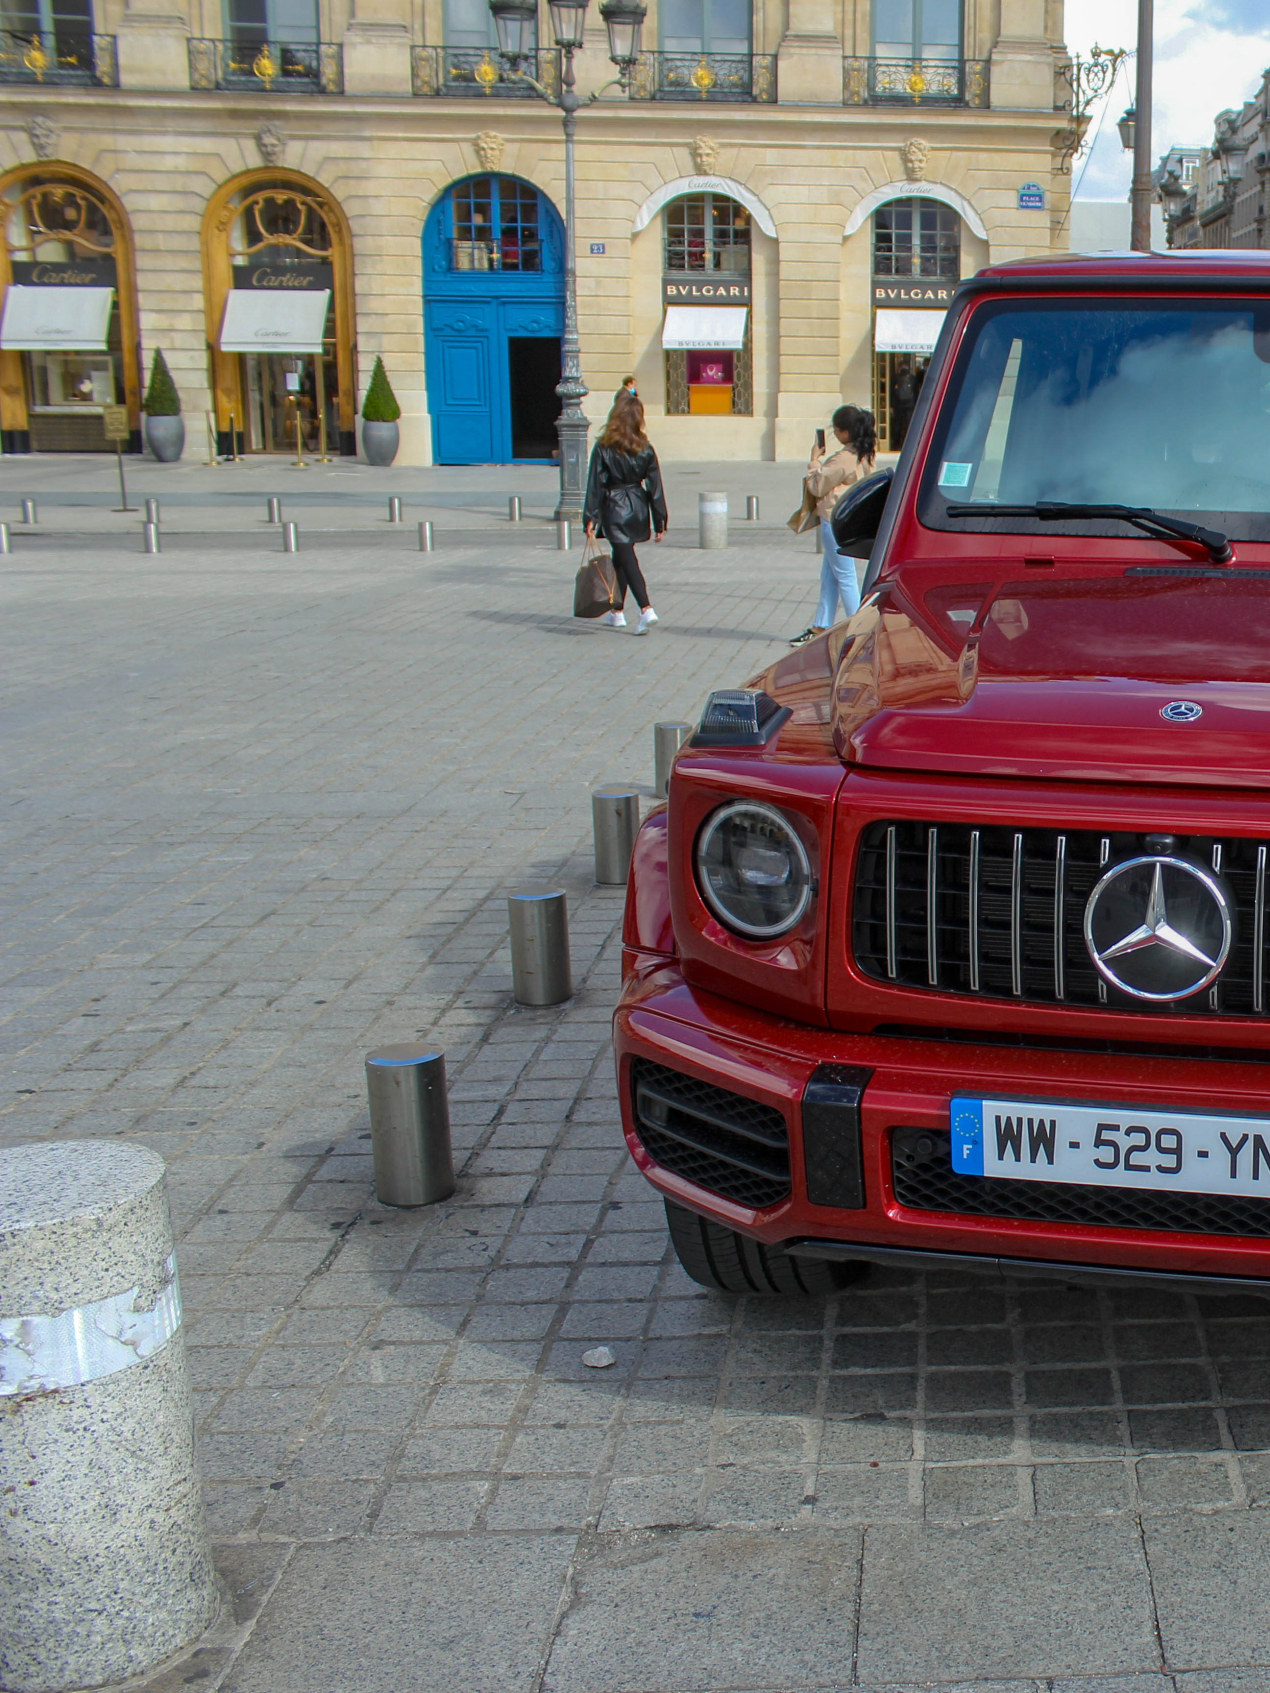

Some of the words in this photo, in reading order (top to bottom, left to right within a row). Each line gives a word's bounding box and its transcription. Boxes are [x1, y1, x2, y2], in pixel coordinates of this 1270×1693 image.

[687, 177, 722, 189] Cartier
[899, 182, 934, 194] Cartier
[592, 244, 604, 254] 23
[31, 263, 98, 285] Cartier
[251, 267, 315, 288] Cartier
[666, 285, 749, 296] BVLGARI
[254, 327, 292, 338] Cartier
[962, 1144, 973, 1160] F
